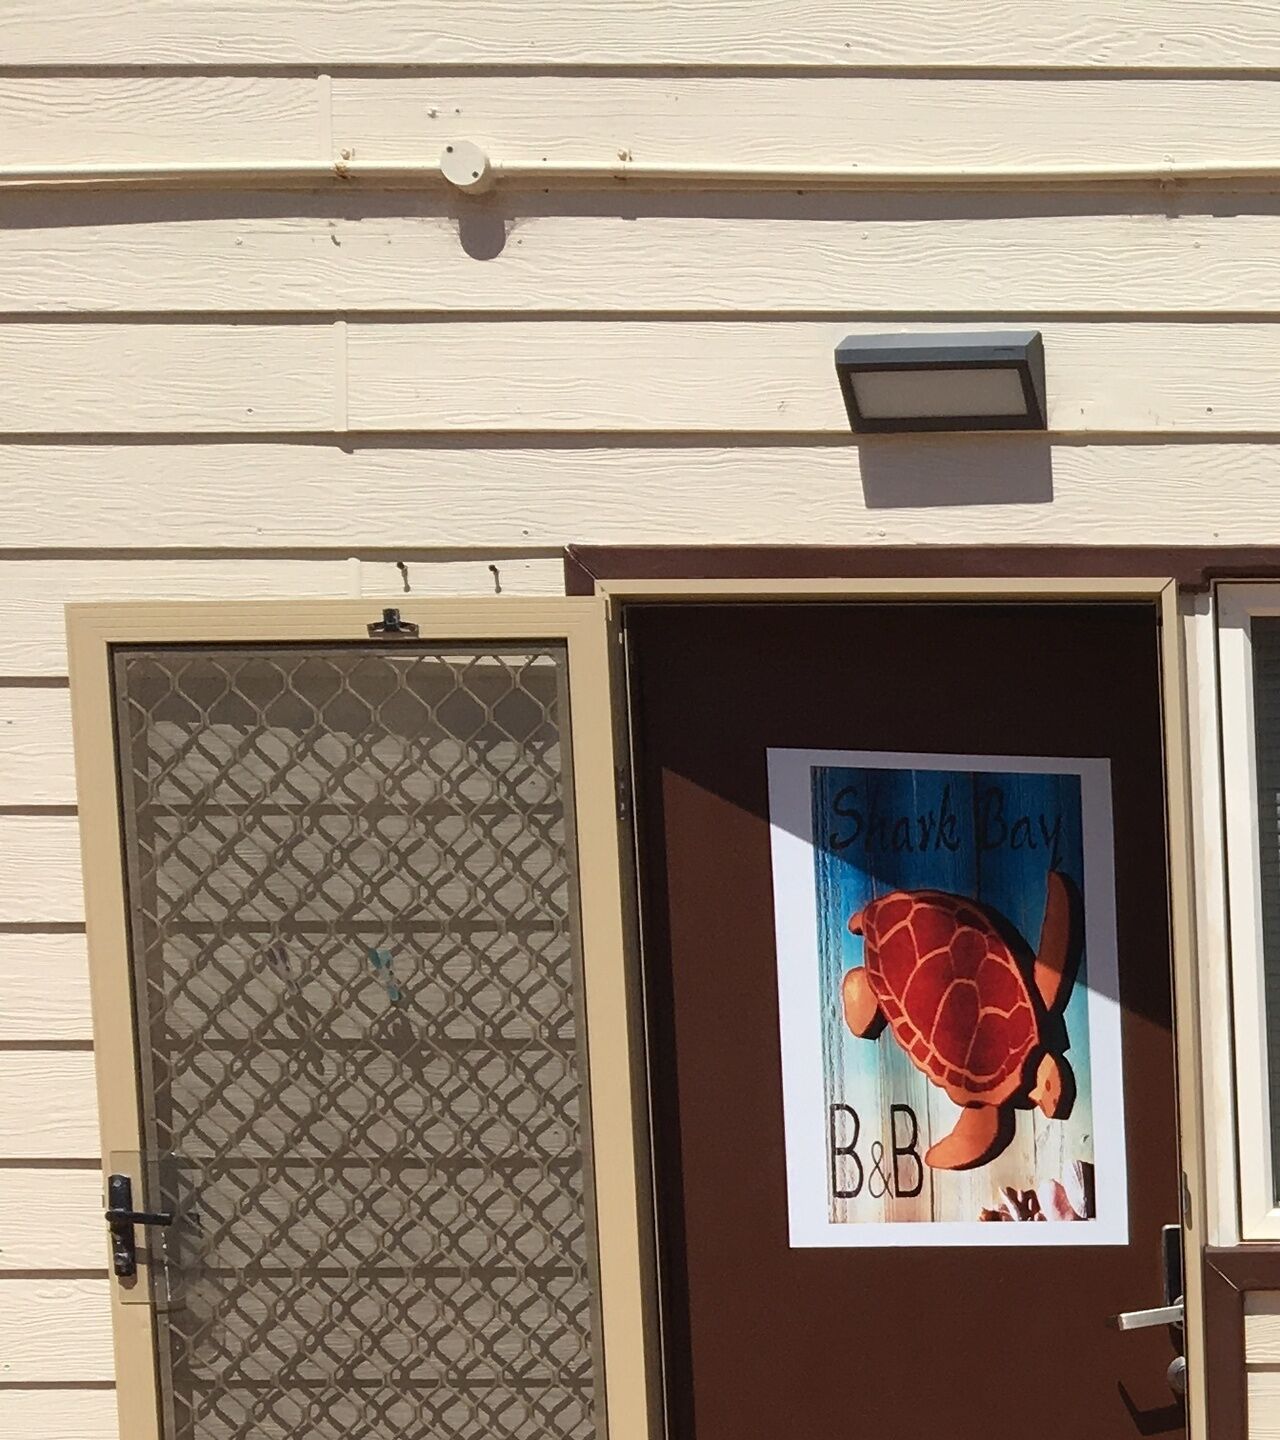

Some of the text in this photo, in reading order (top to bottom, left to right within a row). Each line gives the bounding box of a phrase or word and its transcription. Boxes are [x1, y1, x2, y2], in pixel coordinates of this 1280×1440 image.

[829, 783, 1063, 871] Shark Bay
[829, 1101, 925, 1200] B&B
